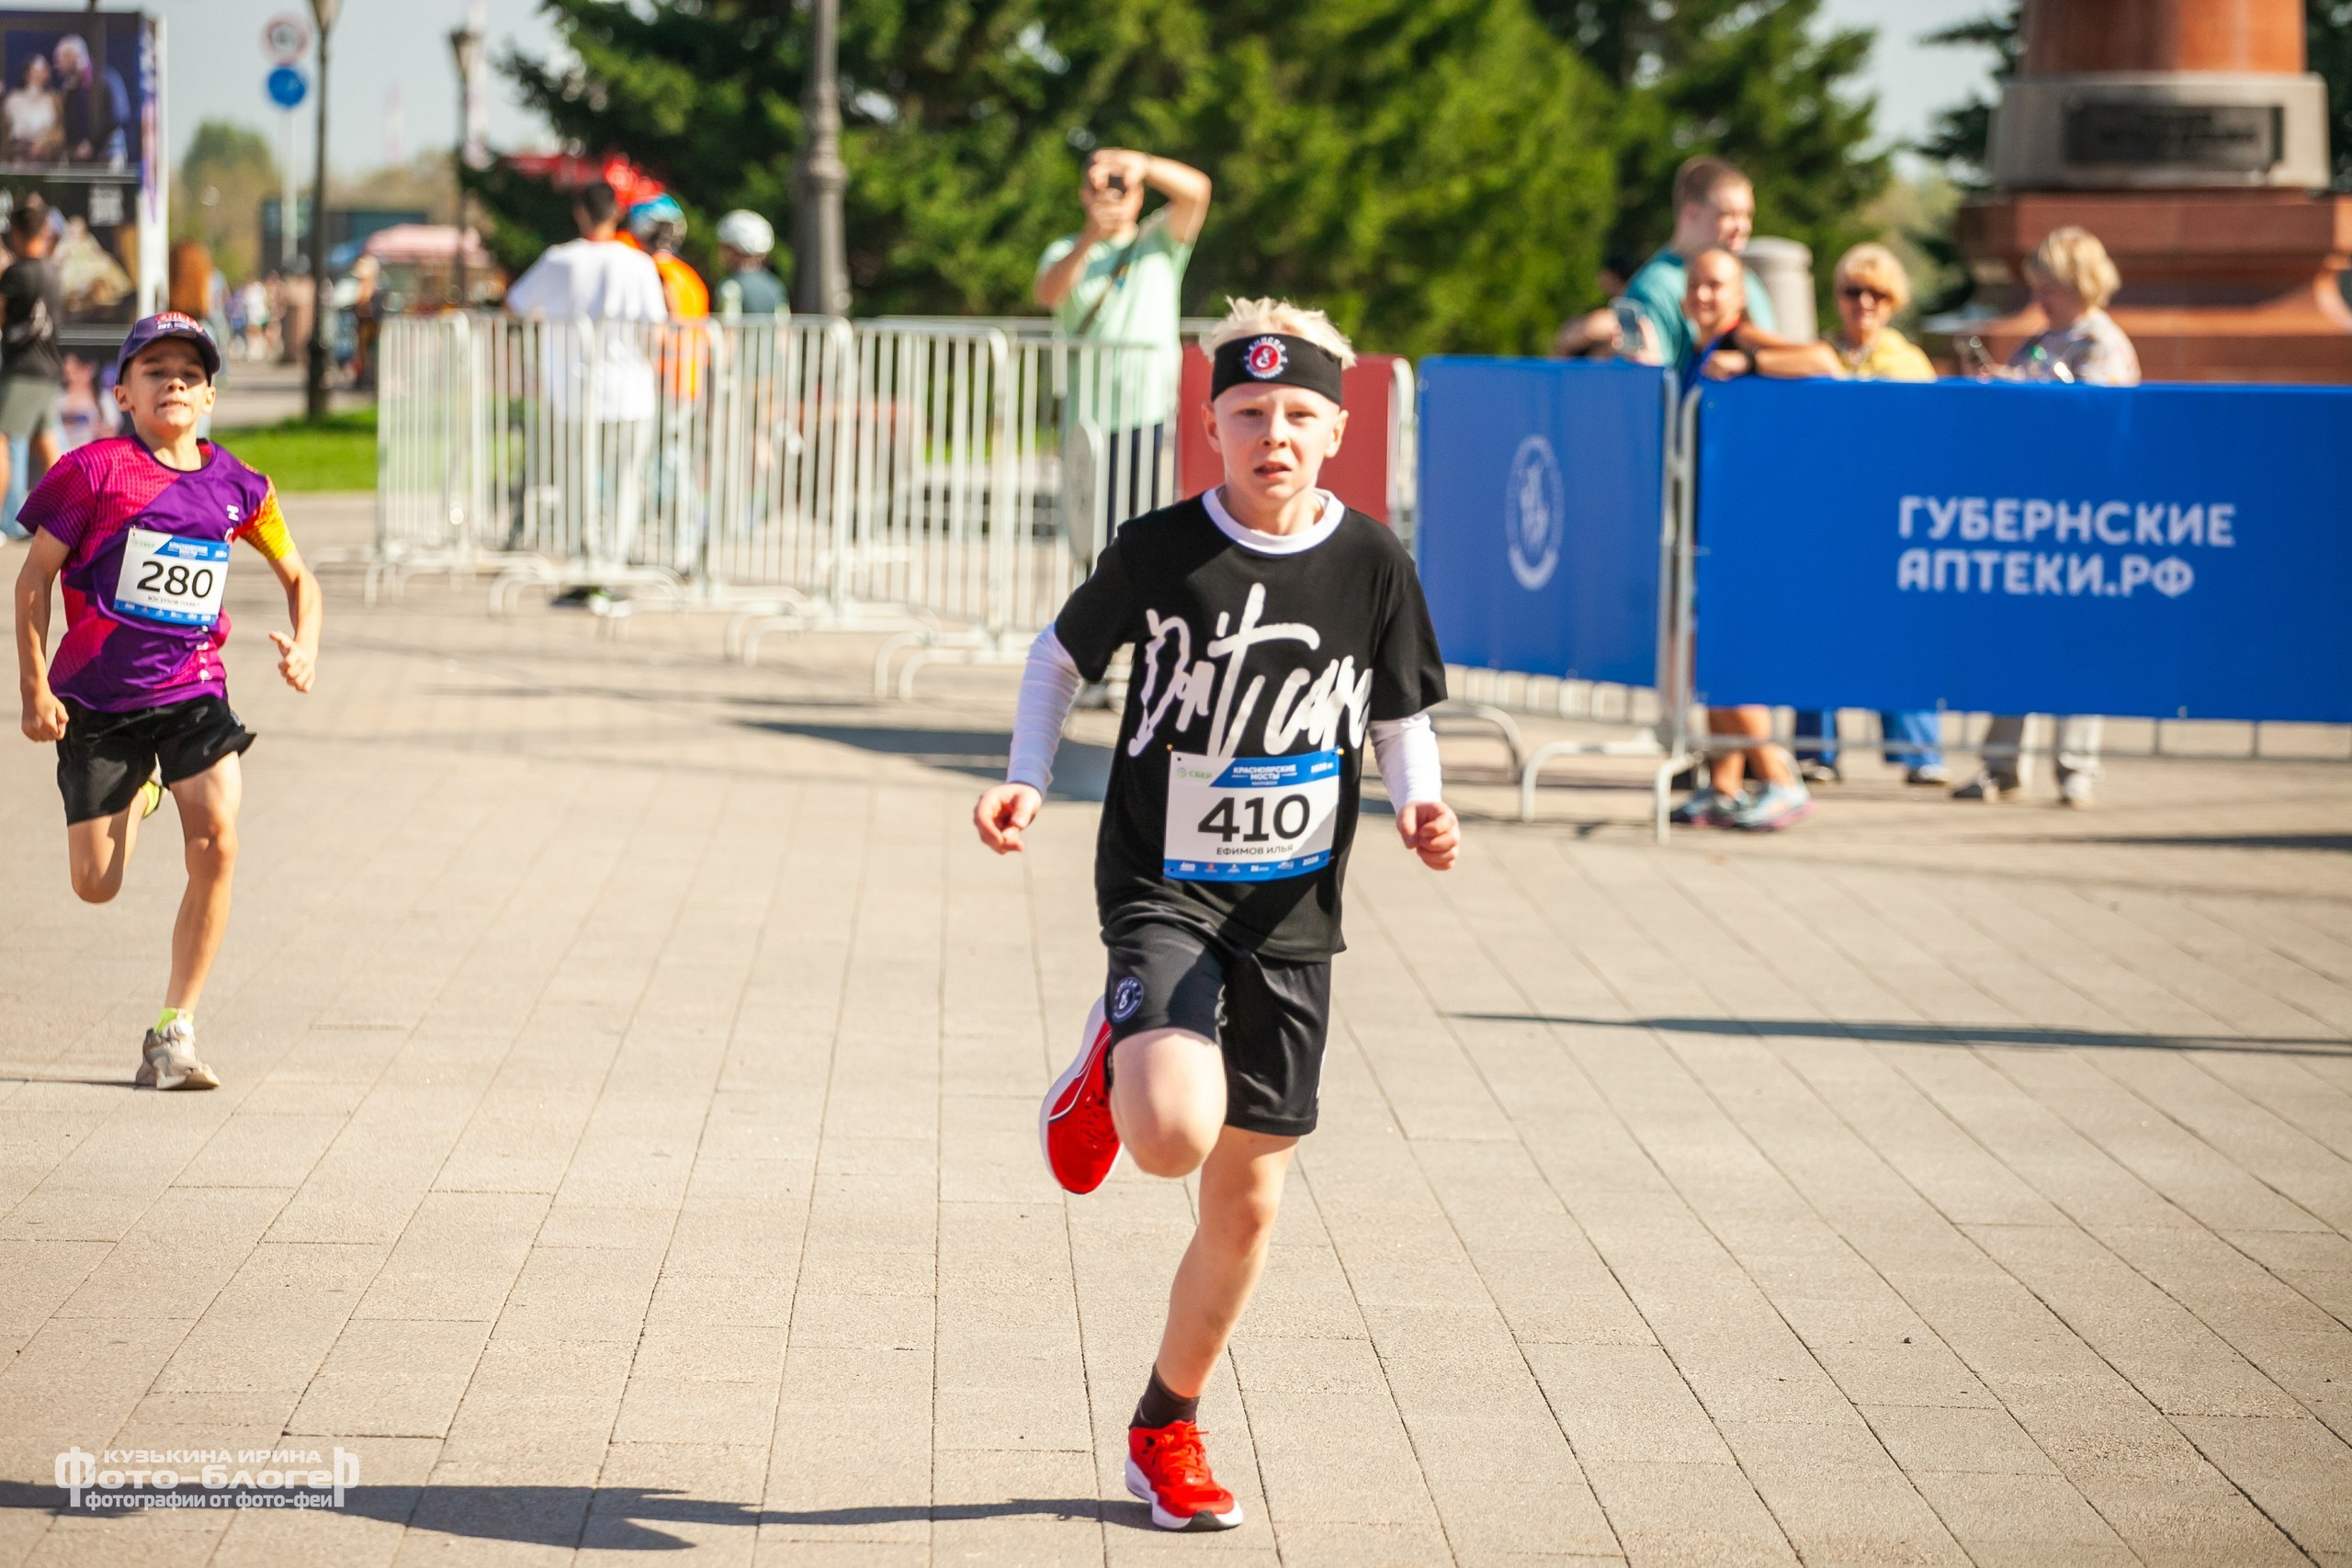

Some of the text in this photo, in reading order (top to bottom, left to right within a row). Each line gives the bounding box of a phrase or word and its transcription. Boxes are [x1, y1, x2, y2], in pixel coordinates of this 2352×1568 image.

[1898, 496, 2236, 547] ГУБЕРНСКИЕ
[137, 561, 213, 598] 280
[1897, 548, 2195, 598] АПТЕКИ.РФ
[1198, 794, 1310, 842] 410
[1216, 844, 1294, 855] ЕФИМОВ ИЛЬЯ
